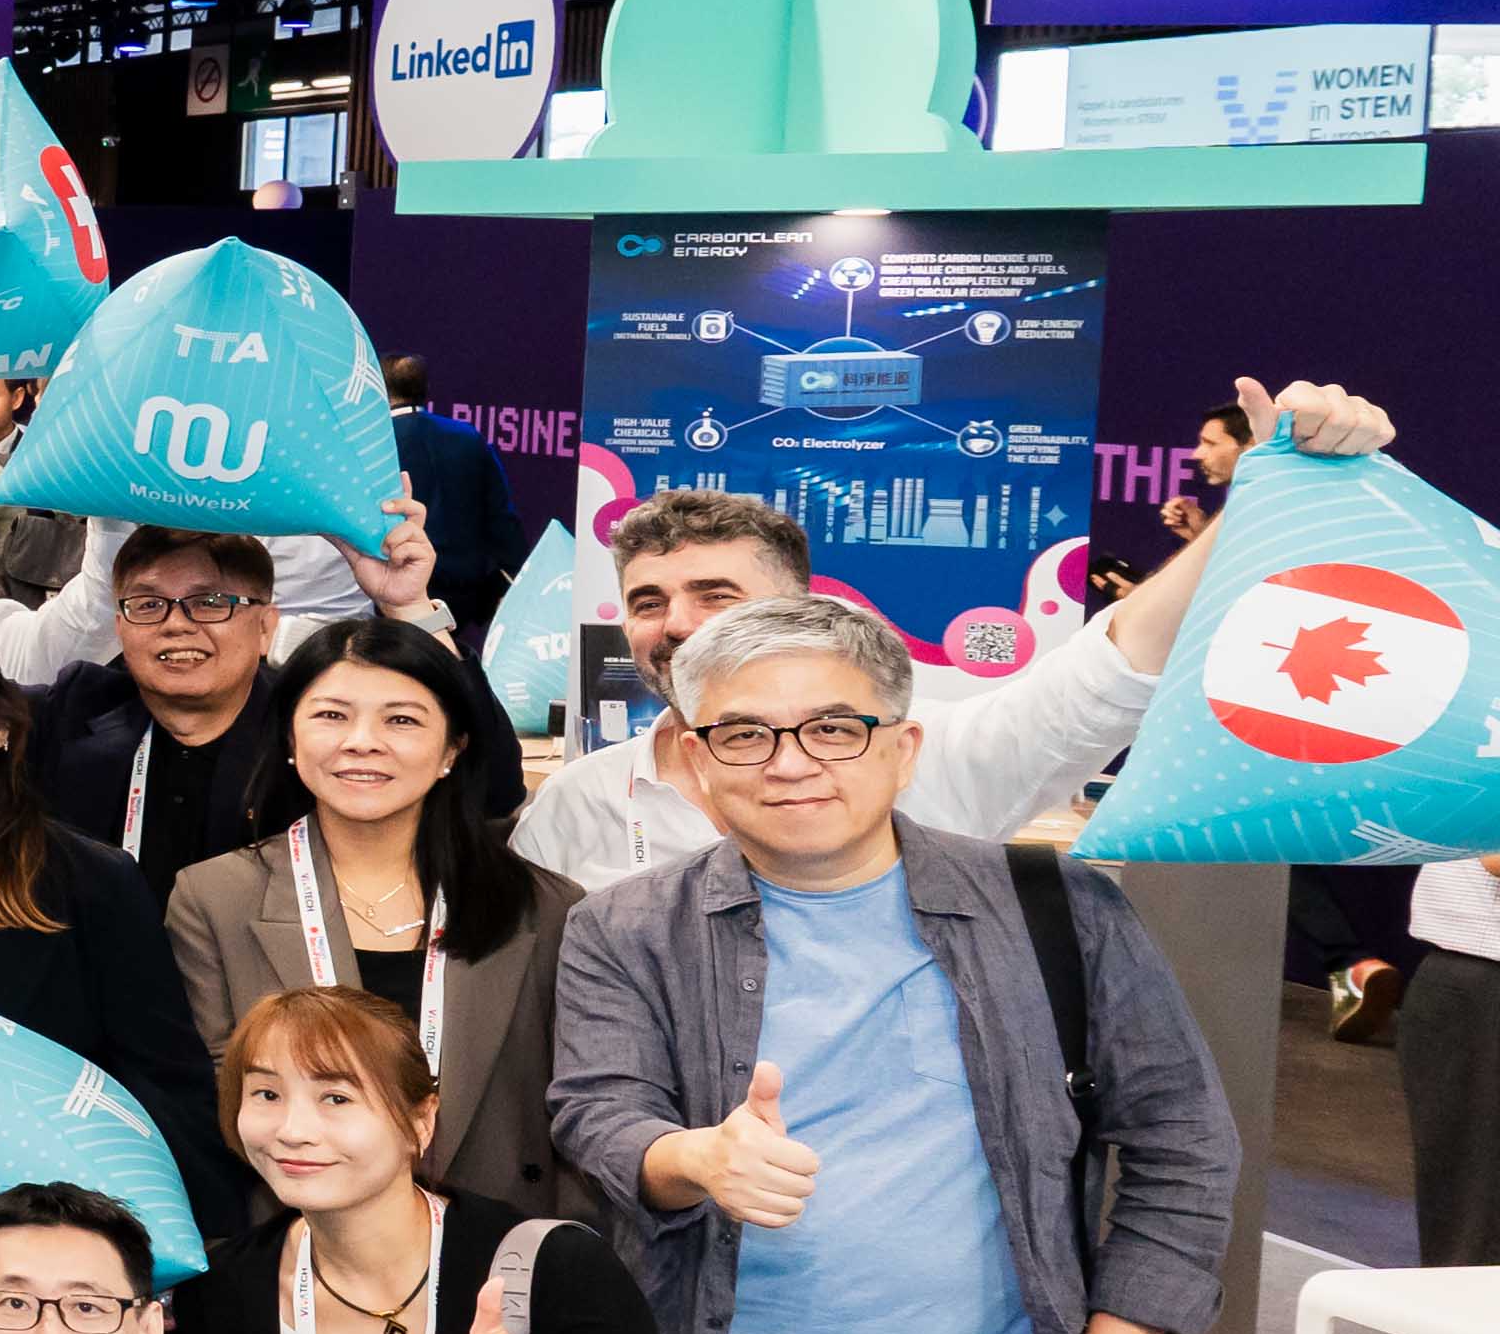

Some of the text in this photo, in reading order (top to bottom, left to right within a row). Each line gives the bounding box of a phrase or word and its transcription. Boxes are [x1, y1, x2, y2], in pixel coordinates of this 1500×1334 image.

[1311, 63, 1415, 93] WOMEN
[1309, 95, 1413, 121] in STEM
[674, 231, 812, 244] CARBONCLEAN
[673, 245, 749, 258] ENERGY
[173, 323, 270, 364] TTA
[802, 437, 887, 452] Electrolyzer
[129, 482, 251, 512] MobiWebX
